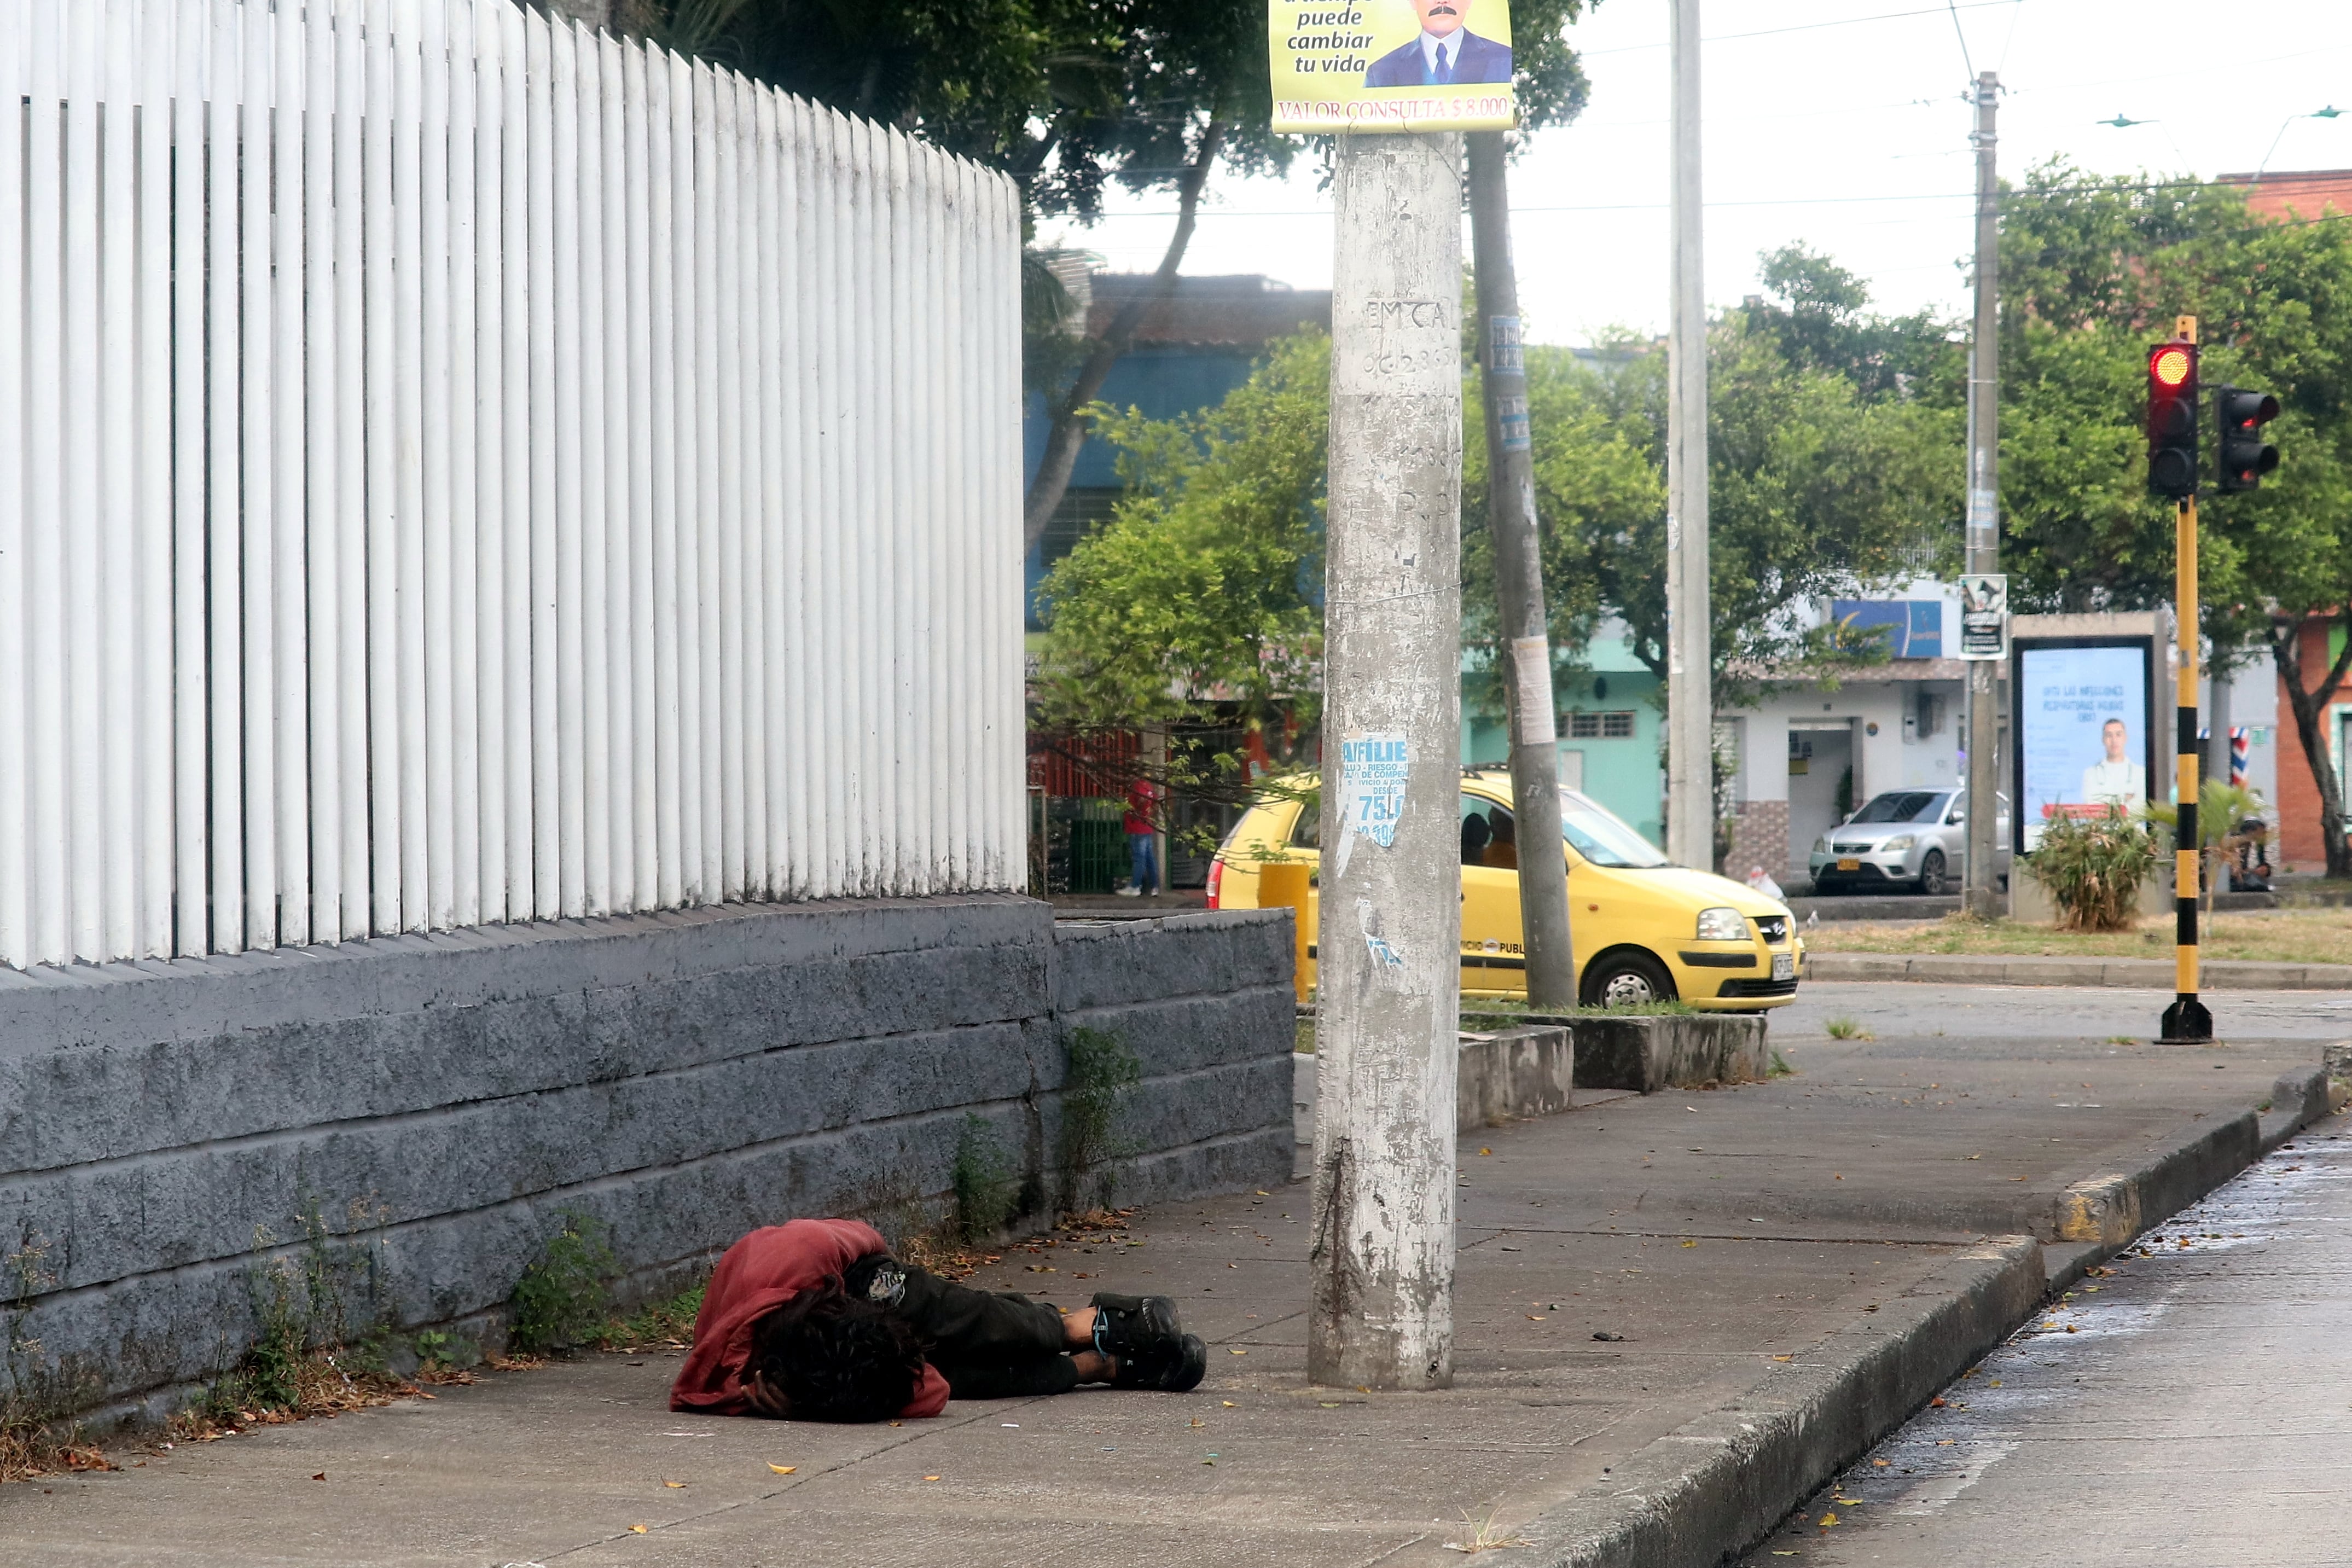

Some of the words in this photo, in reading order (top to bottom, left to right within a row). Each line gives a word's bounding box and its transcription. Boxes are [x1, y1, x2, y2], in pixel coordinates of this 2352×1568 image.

[1297, 7, 1362, 30] puede
[1287, 31, 1373, 49] cambiar
[1296, 56, 1316, 72] tu
[1322, 54, 1366, 72] vida
[1277, 102, 1341, 119] VALOR
[1346, 100, 1446, 120] CONSULTA
[1453, 97, 1461, 117] $
[1466, 97, 1507, 116] 8.000
